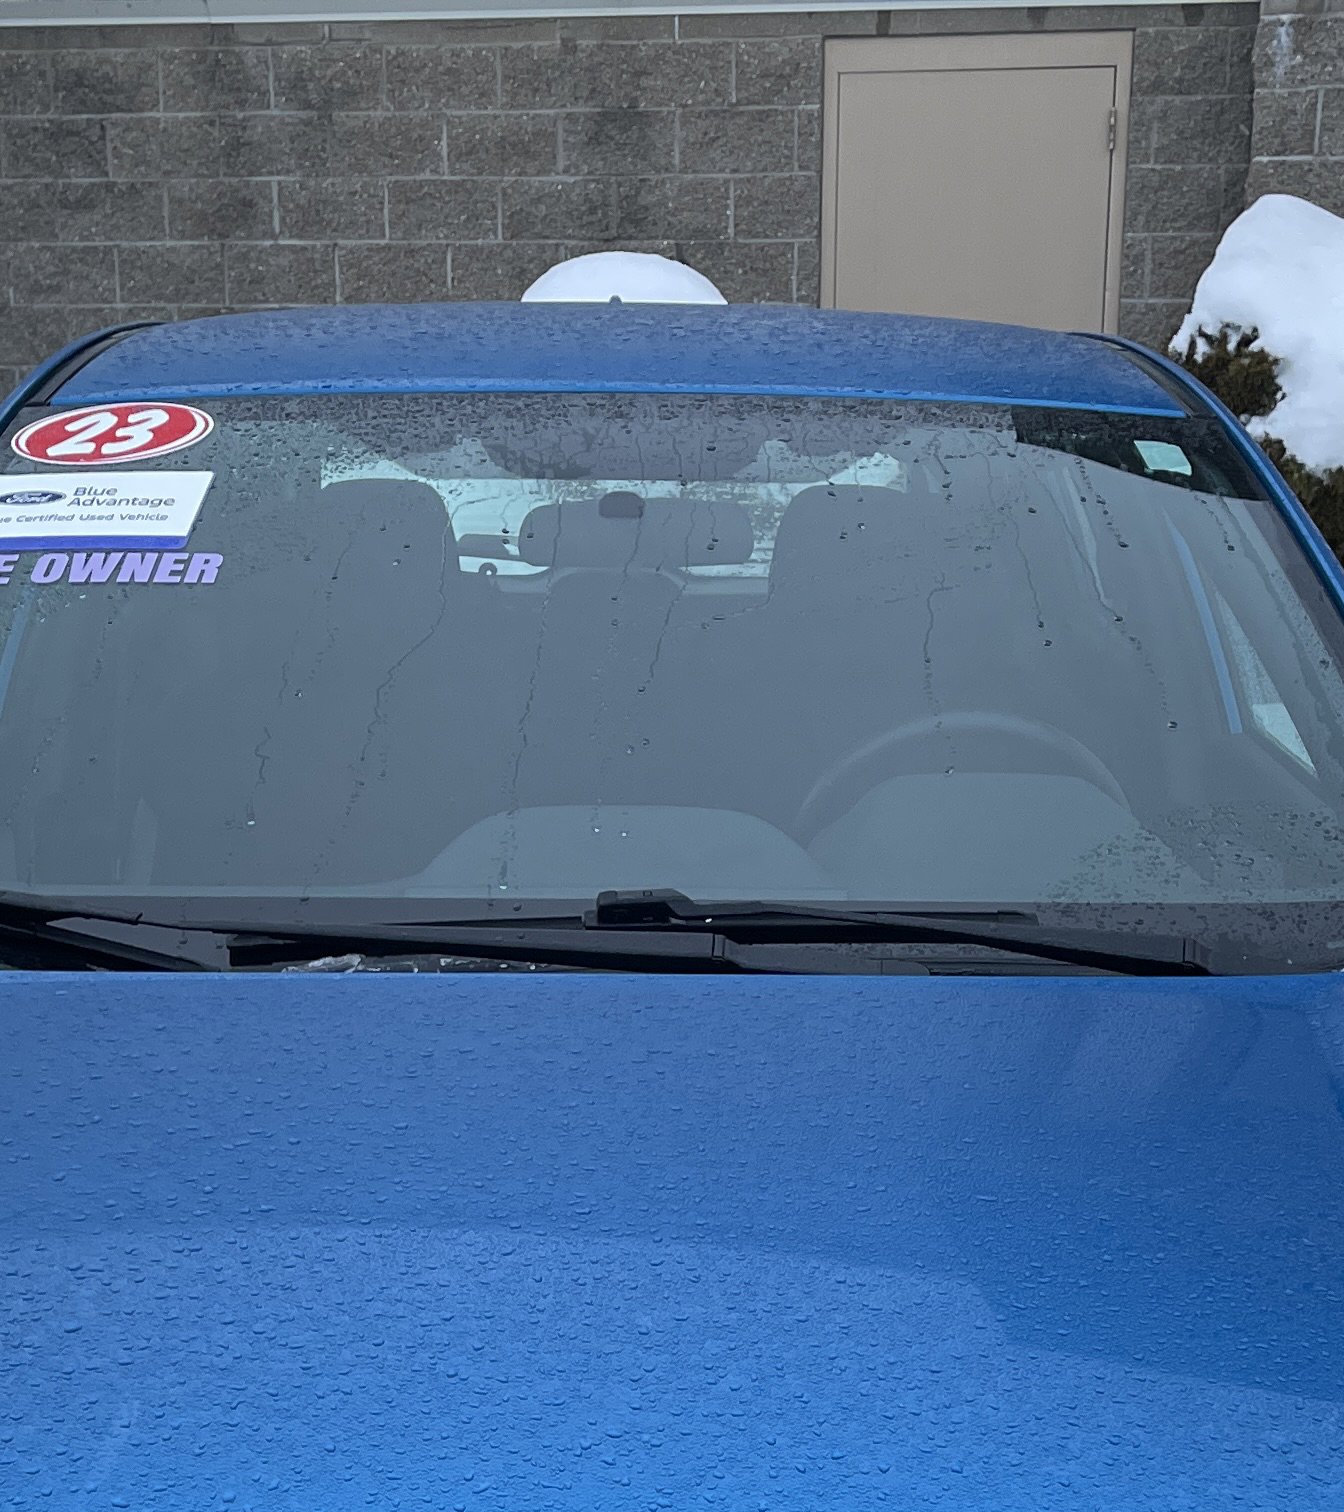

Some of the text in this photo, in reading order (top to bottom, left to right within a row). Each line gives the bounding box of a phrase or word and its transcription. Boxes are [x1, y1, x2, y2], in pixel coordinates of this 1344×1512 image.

[45, 408, 170, 457] 23
[73, 486, 118, 496] Blue
[67, 496, 176, 508] Advantage
[15, 513, 75, 523] Certified
[79, 513, 115, 521] Used
[119, 513, 169, 521] Vehicle
[30, 551, 225, 585] OWNER
